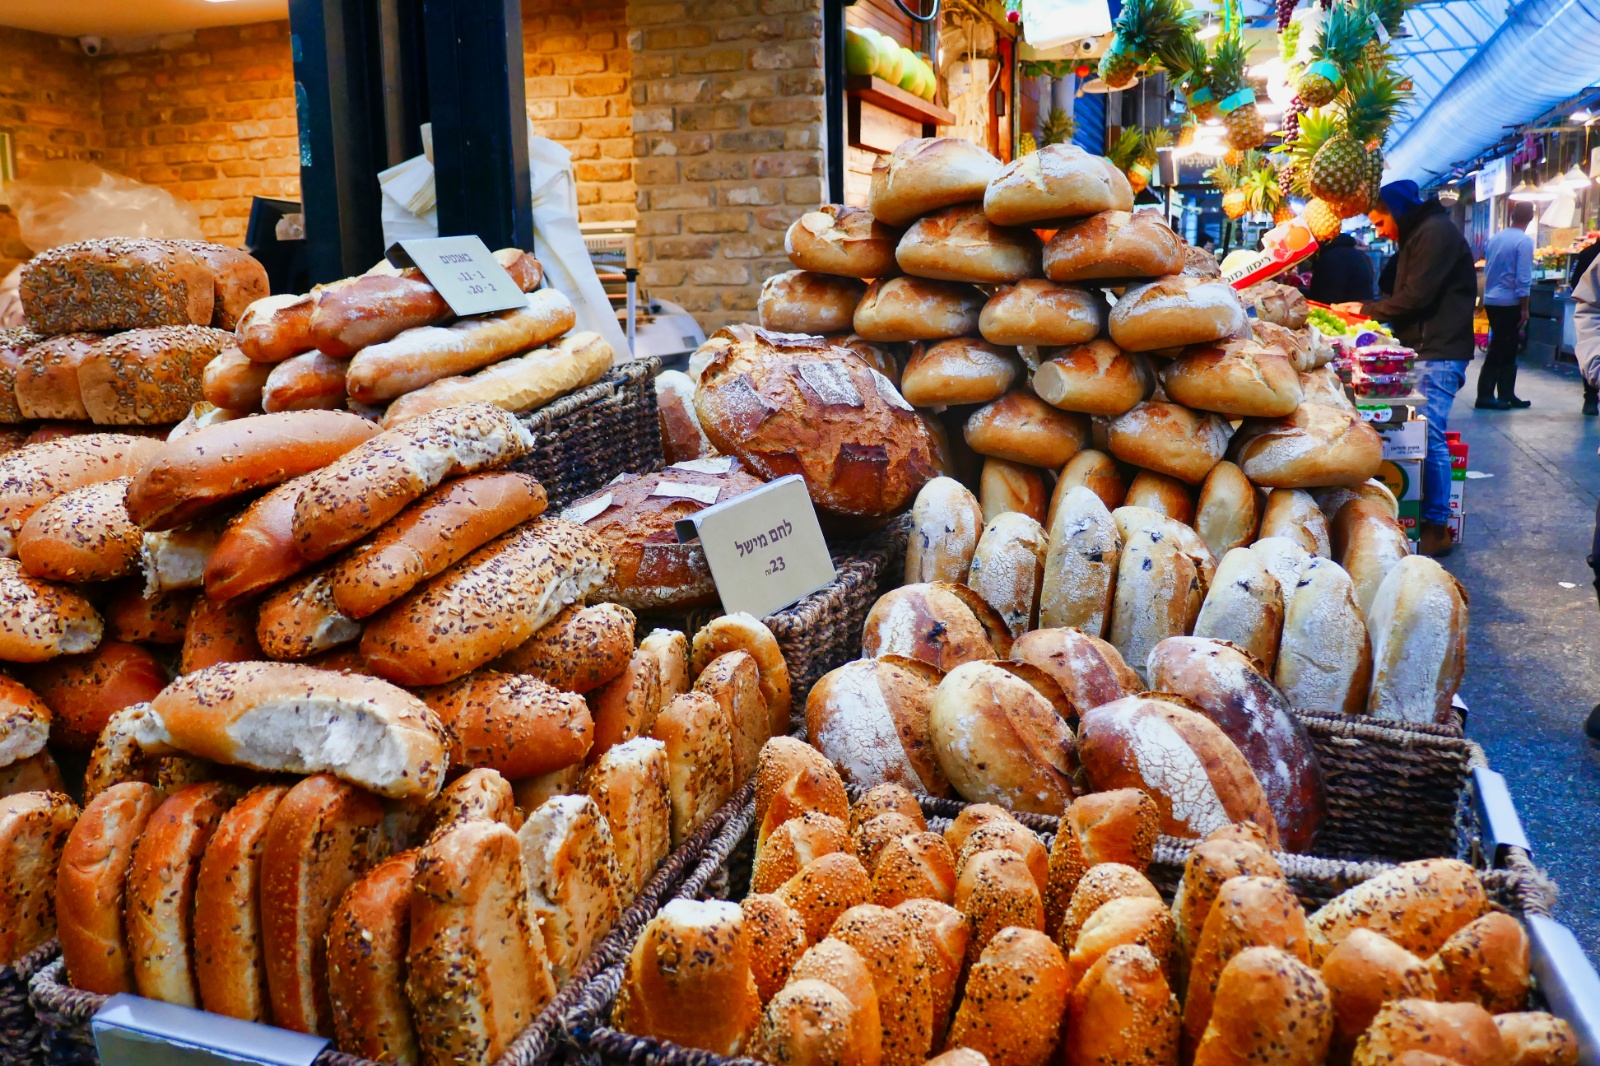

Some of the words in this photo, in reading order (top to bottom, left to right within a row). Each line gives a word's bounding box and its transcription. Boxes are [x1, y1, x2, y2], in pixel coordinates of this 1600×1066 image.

[1246, 256, 1271, 274] רימון
[768, 519, 793, 543] לחם
[734, 533, 768, 558] מישל
